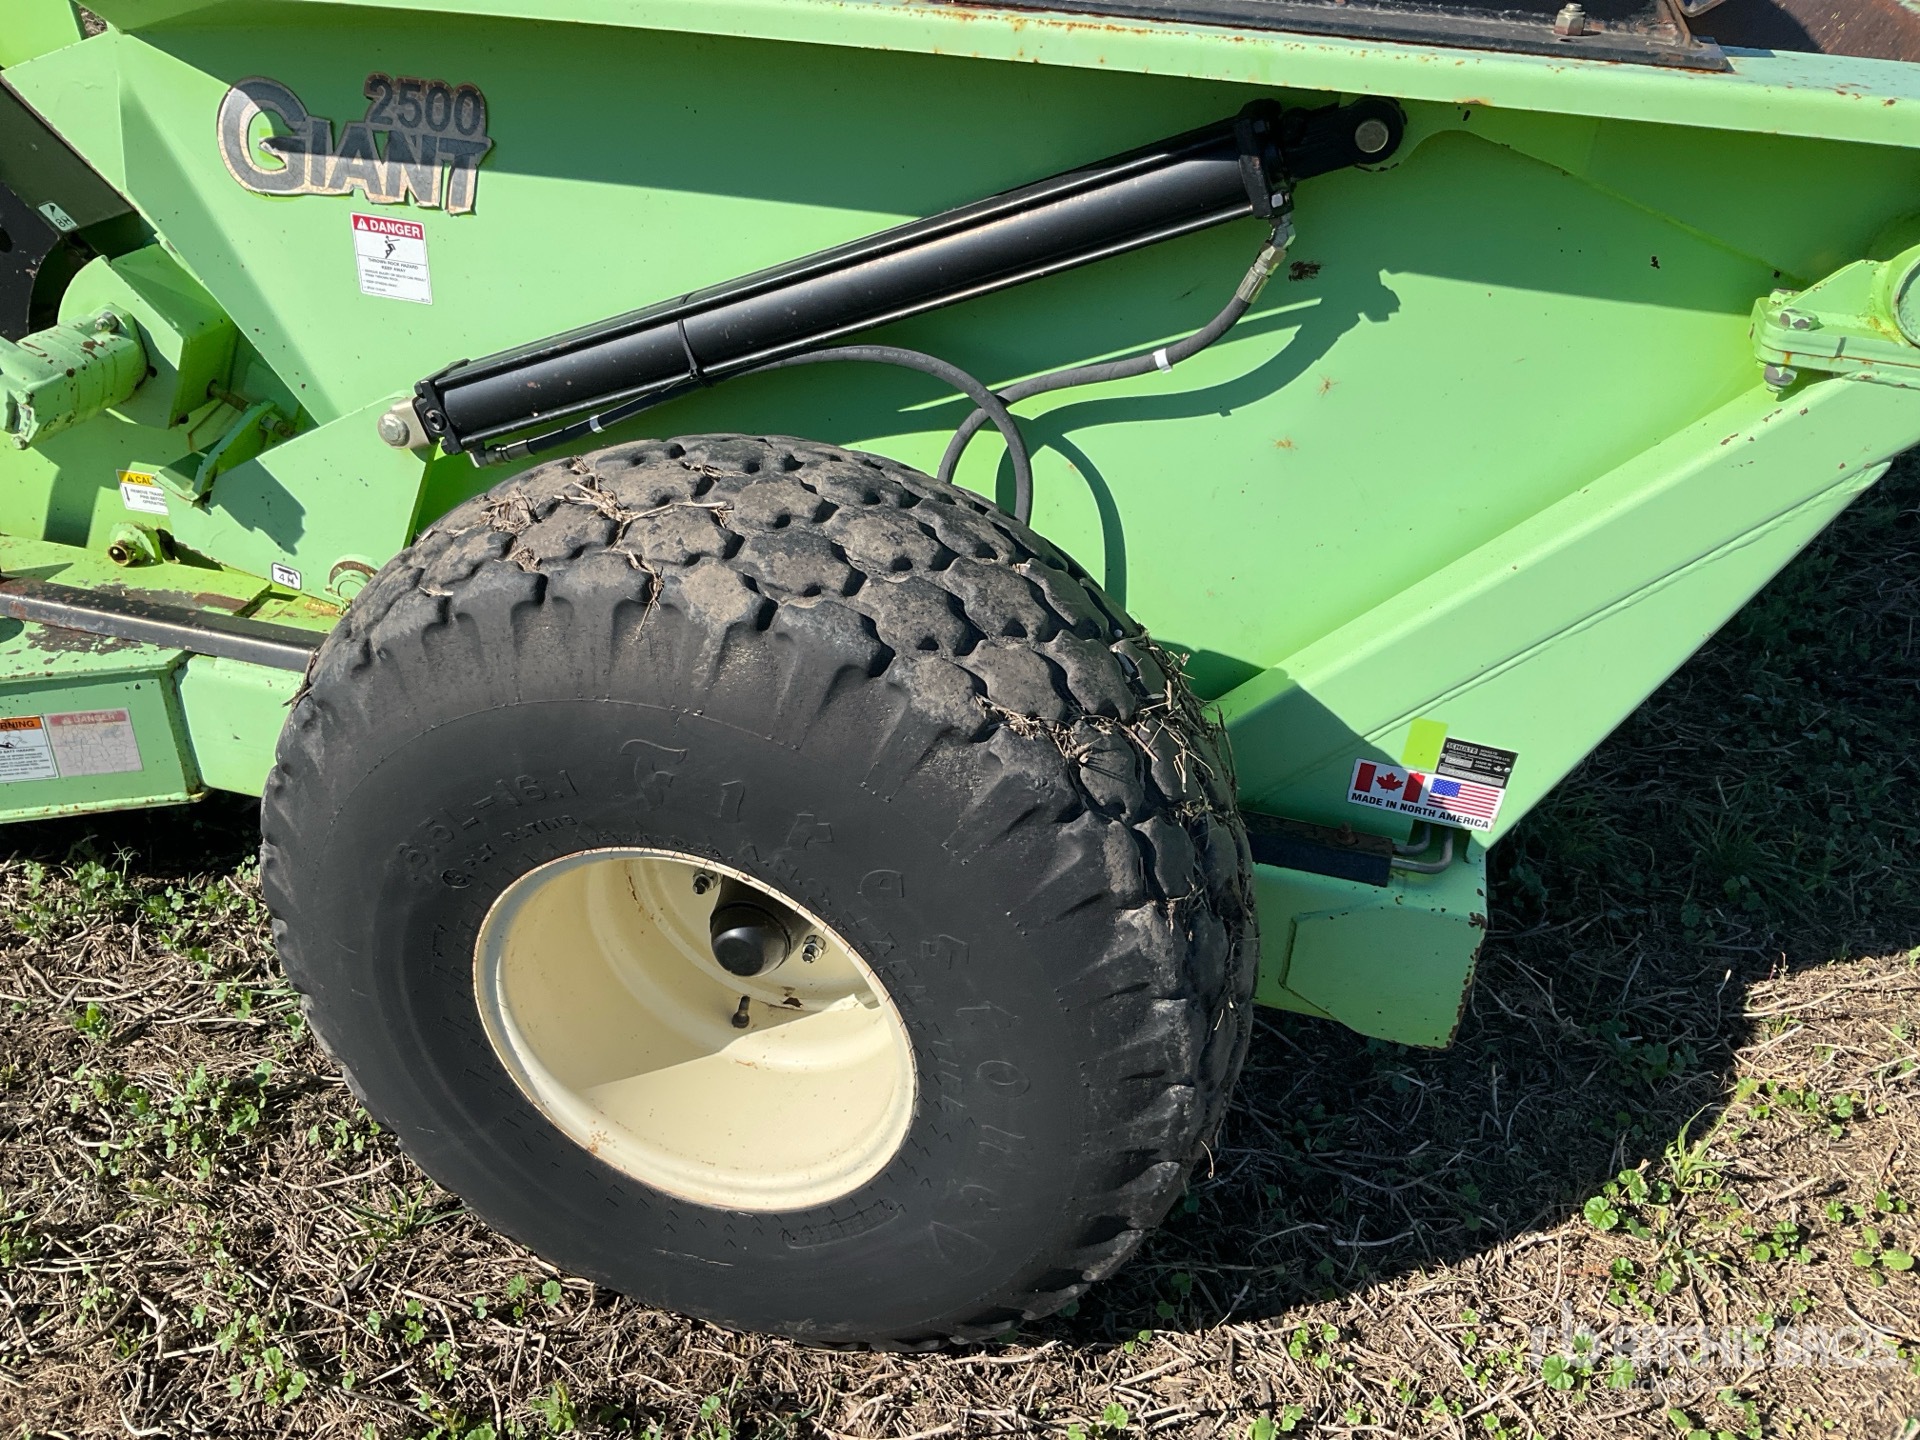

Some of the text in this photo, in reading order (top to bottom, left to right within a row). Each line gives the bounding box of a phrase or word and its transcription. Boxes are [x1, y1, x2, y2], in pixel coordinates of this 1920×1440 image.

[367, 77, 482, 136] 2500
[220, 79, 490, 209] GIANT
[370, 219, 421, 238] DANGER
[1351, 792, 1490, 829] MADE IN NORTH AMERICA
